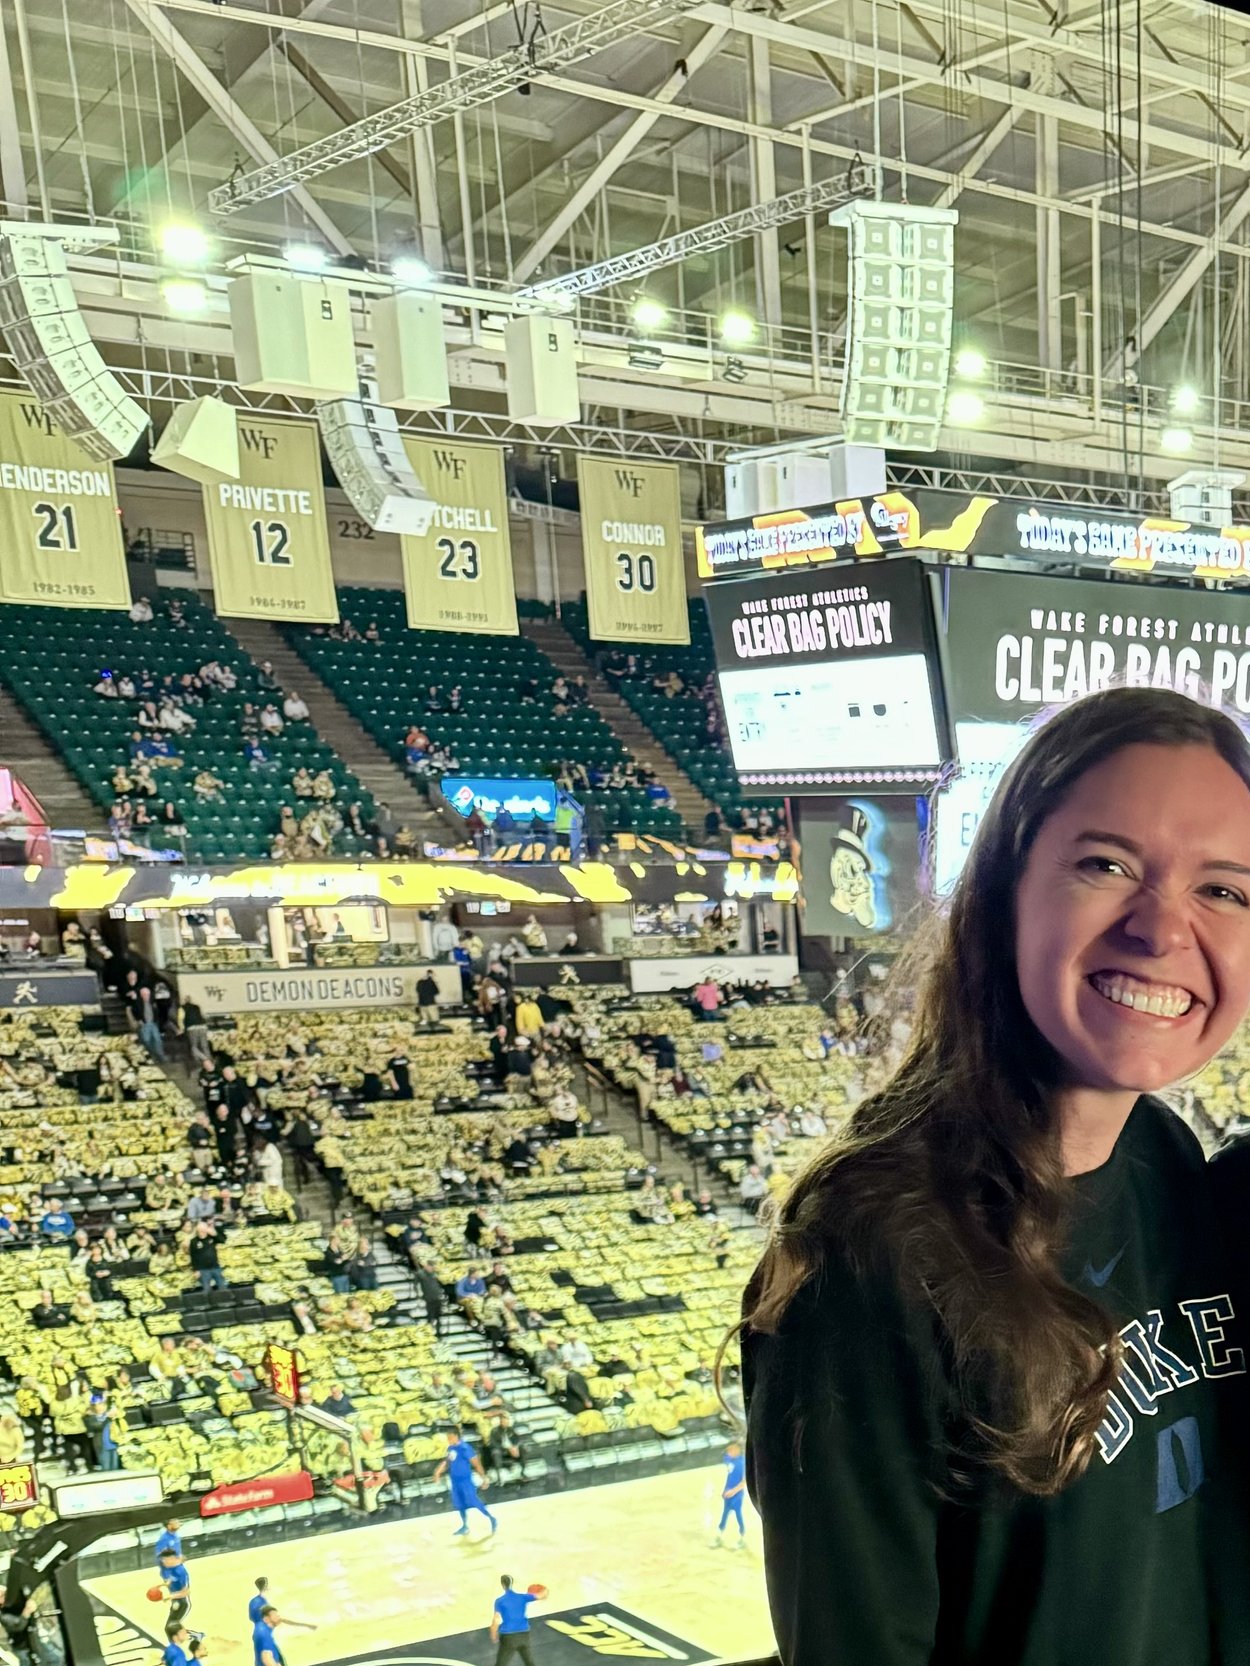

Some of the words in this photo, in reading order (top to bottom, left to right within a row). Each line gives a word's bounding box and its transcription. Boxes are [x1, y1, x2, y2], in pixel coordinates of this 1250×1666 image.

[240, 428, 278, 460] WF
[0, 462, 111, 497] ENDERSON
[433, 450, 467, 480] WF
[219, 483, 313, 515] PRIVETTE
[614, 470, 646, 498] WF
[32, 500, 81, 552] 21
[338, 520, 376, 540] 232
[429, 505, 498, 532] TCHELL
[602, 520, 666, 547] CONNOR
[250, 519, 294, 567] 12
[435, 536, 483, 583] 23
[615, 551, 658, 594] 30
[731, 612, 790, 658] CLEAR
[786, 607, 827, 653] BAG
[826, 600, 892, 649] POLICY
[1030, 609, 1086, 633] WAKE
[1099, 613, 1179, 640] FOREST
[995, 634, 1116, 704] CLEAR
[1126, 642, 1201, 701] BAG
[246, 978, 314, 1003] DEMON
[317, 976, 404, 1000] DEACONS
[1, 1482, 28, 1503] 30
